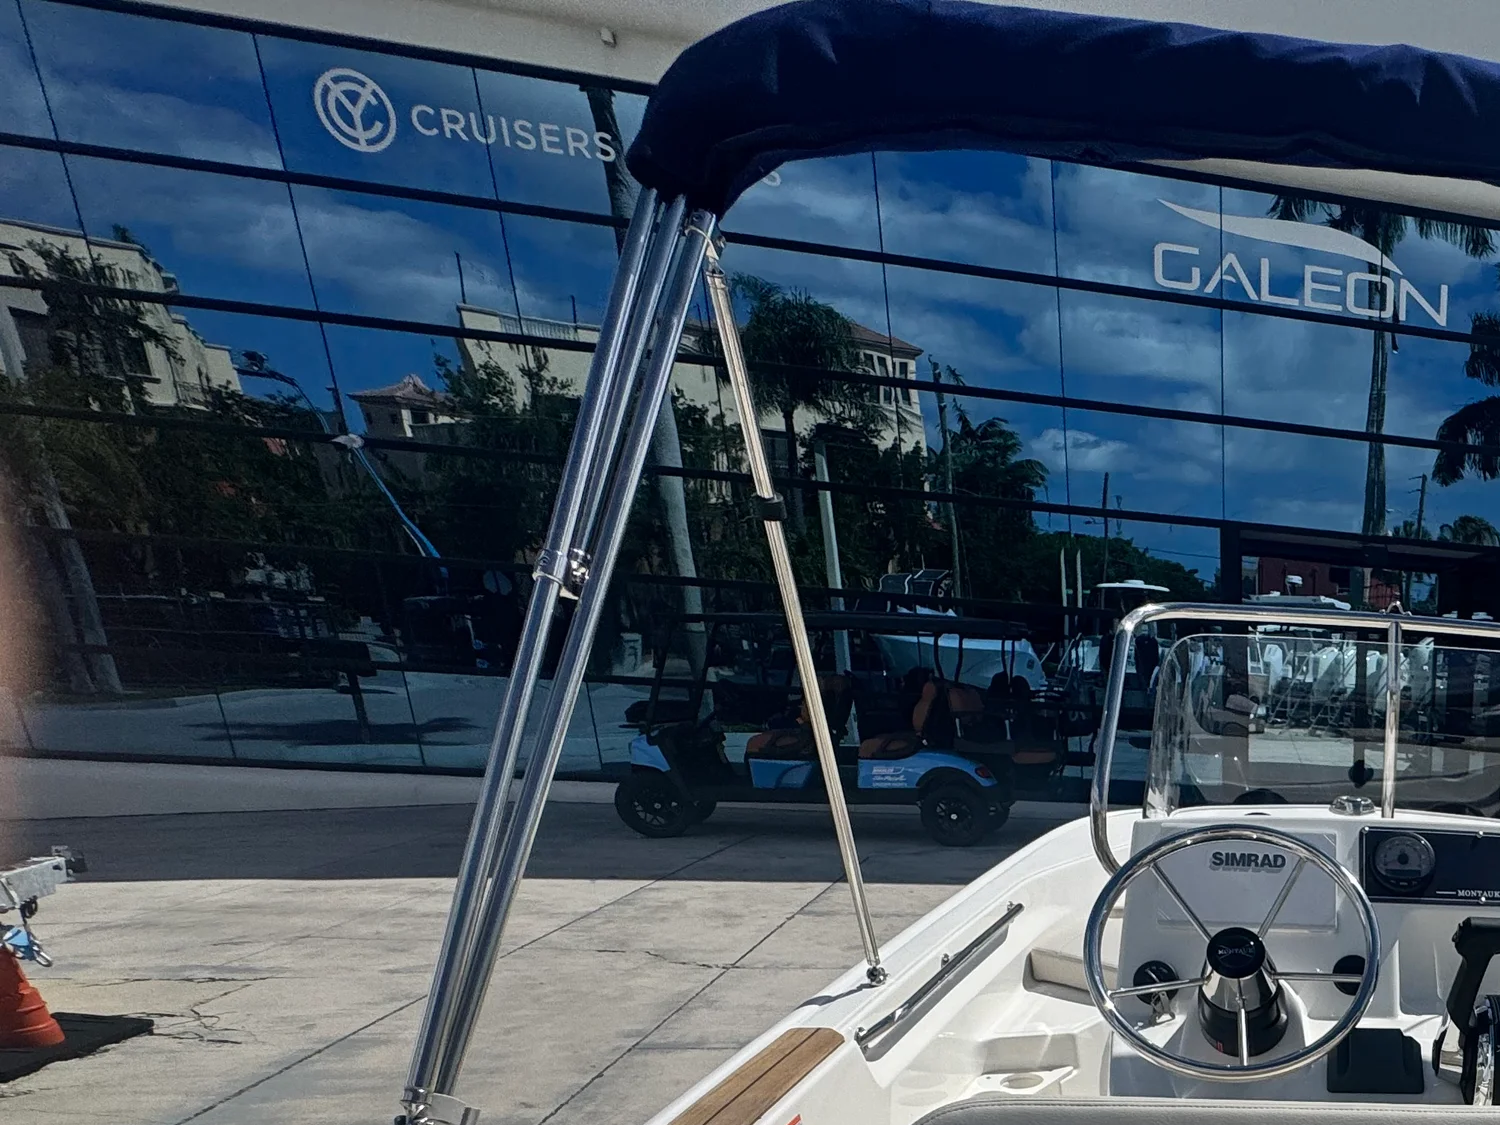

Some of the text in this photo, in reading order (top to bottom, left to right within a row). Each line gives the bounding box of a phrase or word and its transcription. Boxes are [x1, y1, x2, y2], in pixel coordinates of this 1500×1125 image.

[411, 104, 617, 163] CRUISERS
[1153, 242, 1449, 328] GALEON
[1211, 851, 1286, 868] SIMRAD
[1457, 889, 1500, 898] MONTAUK
